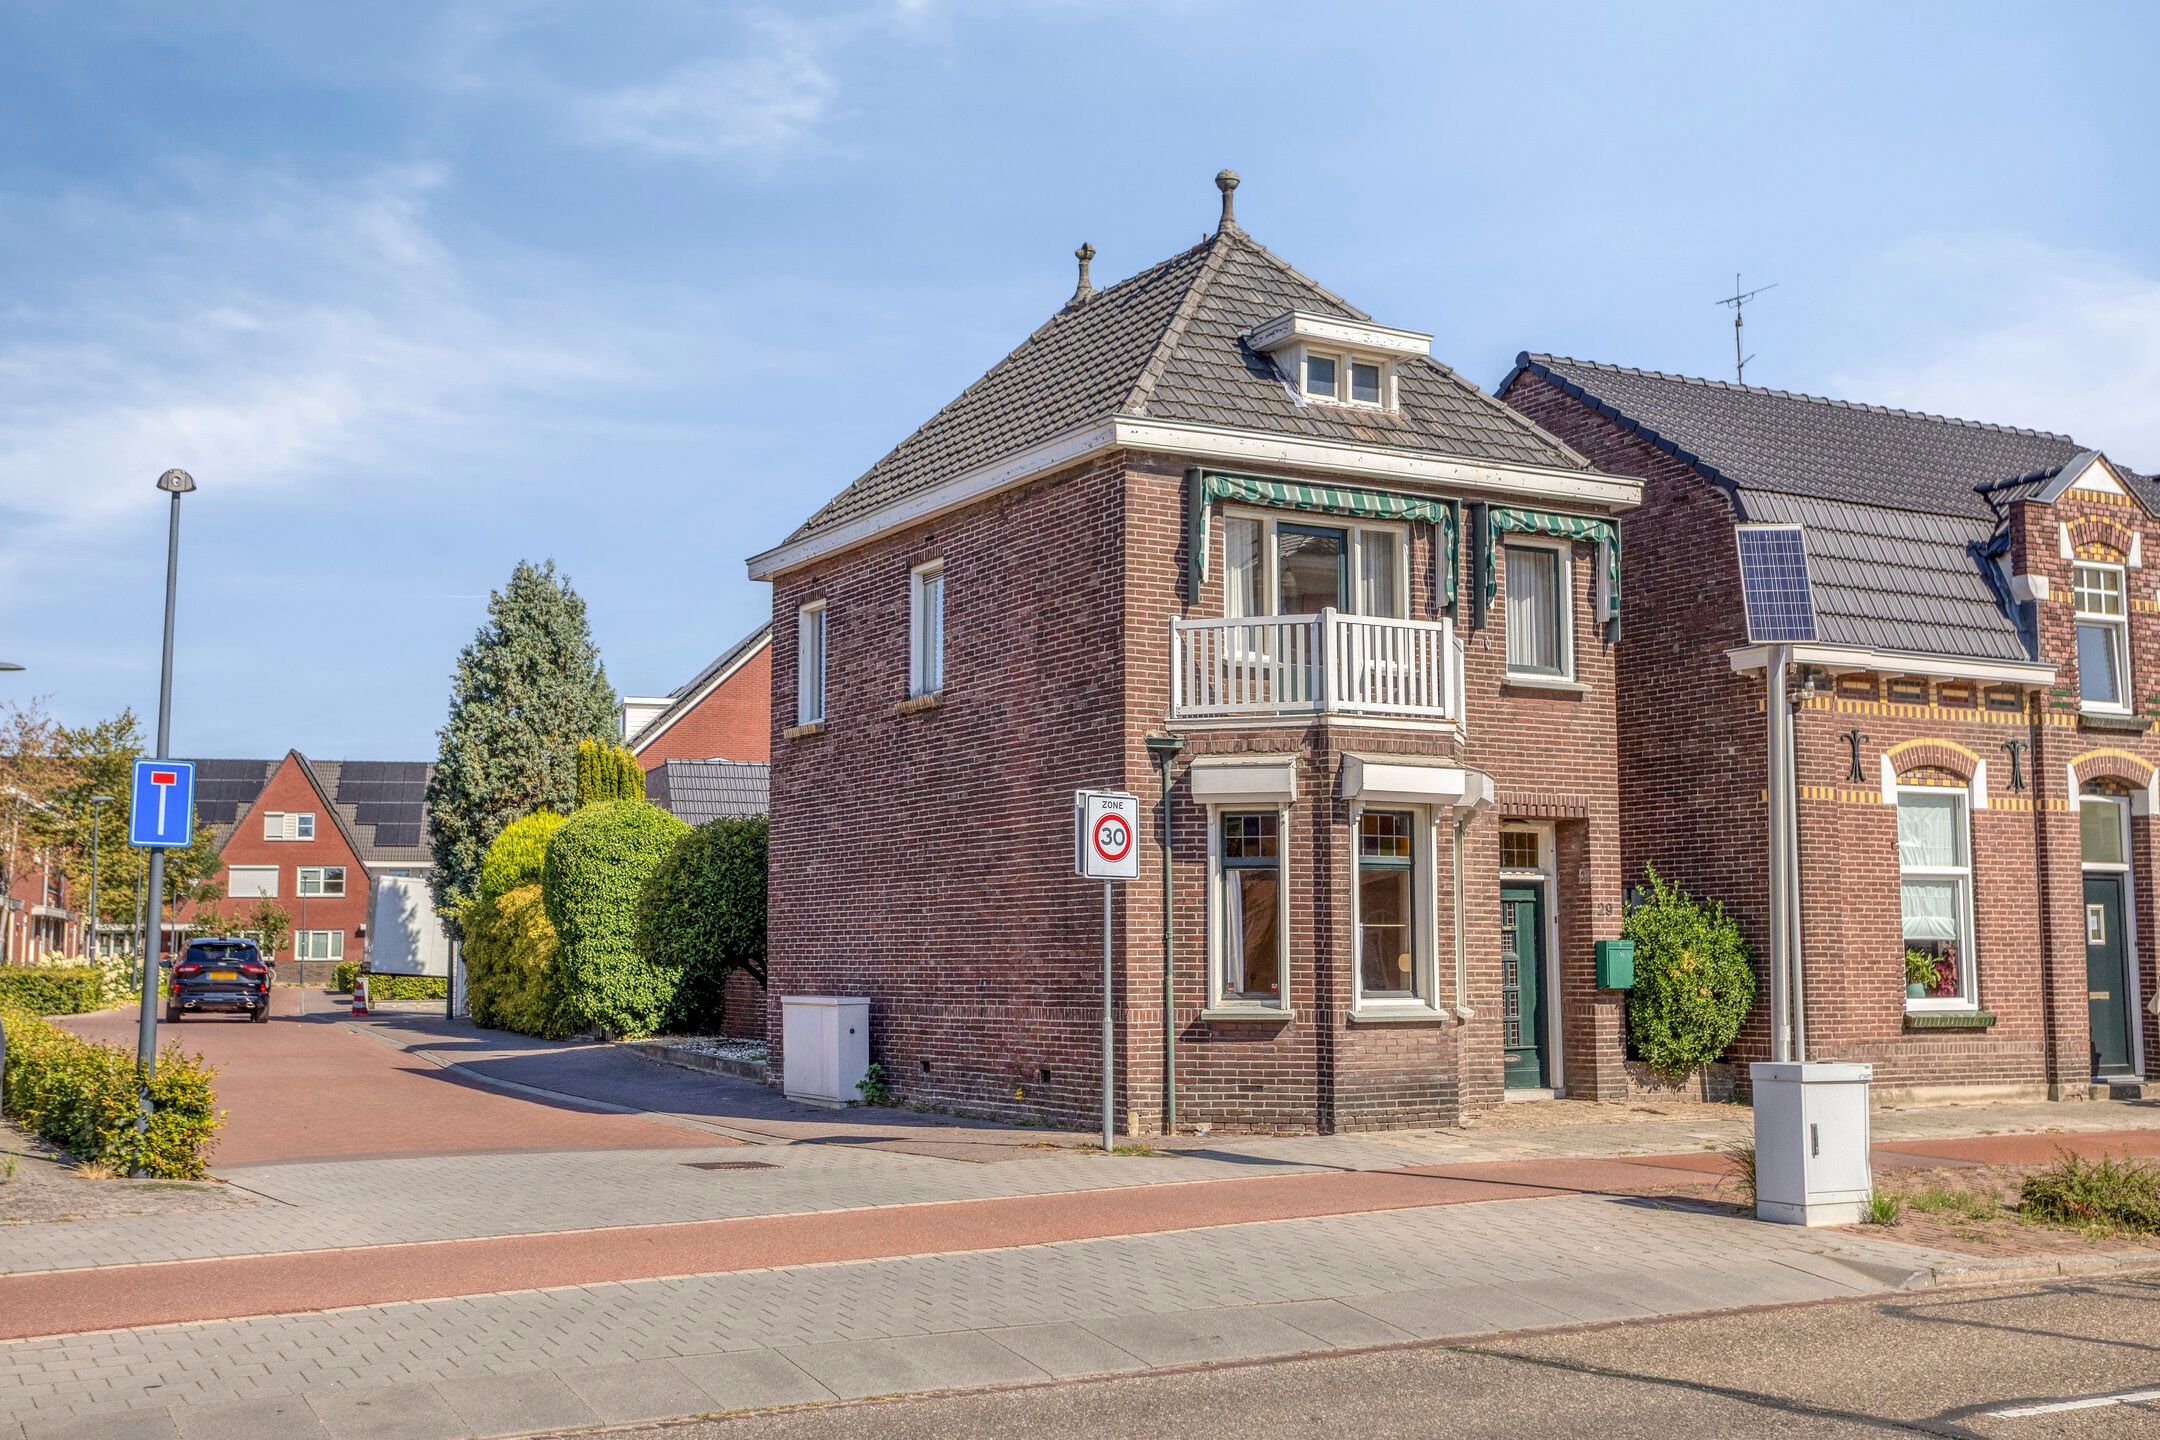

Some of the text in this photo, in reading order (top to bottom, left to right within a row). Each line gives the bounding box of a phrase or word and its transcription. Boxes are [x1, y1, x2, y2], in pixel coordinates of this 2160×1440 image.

[1101, 800, 1124, 810] ZONE
[1100, 827, 1126, 847] 30
[1597, 902, 1613, 917] 29
